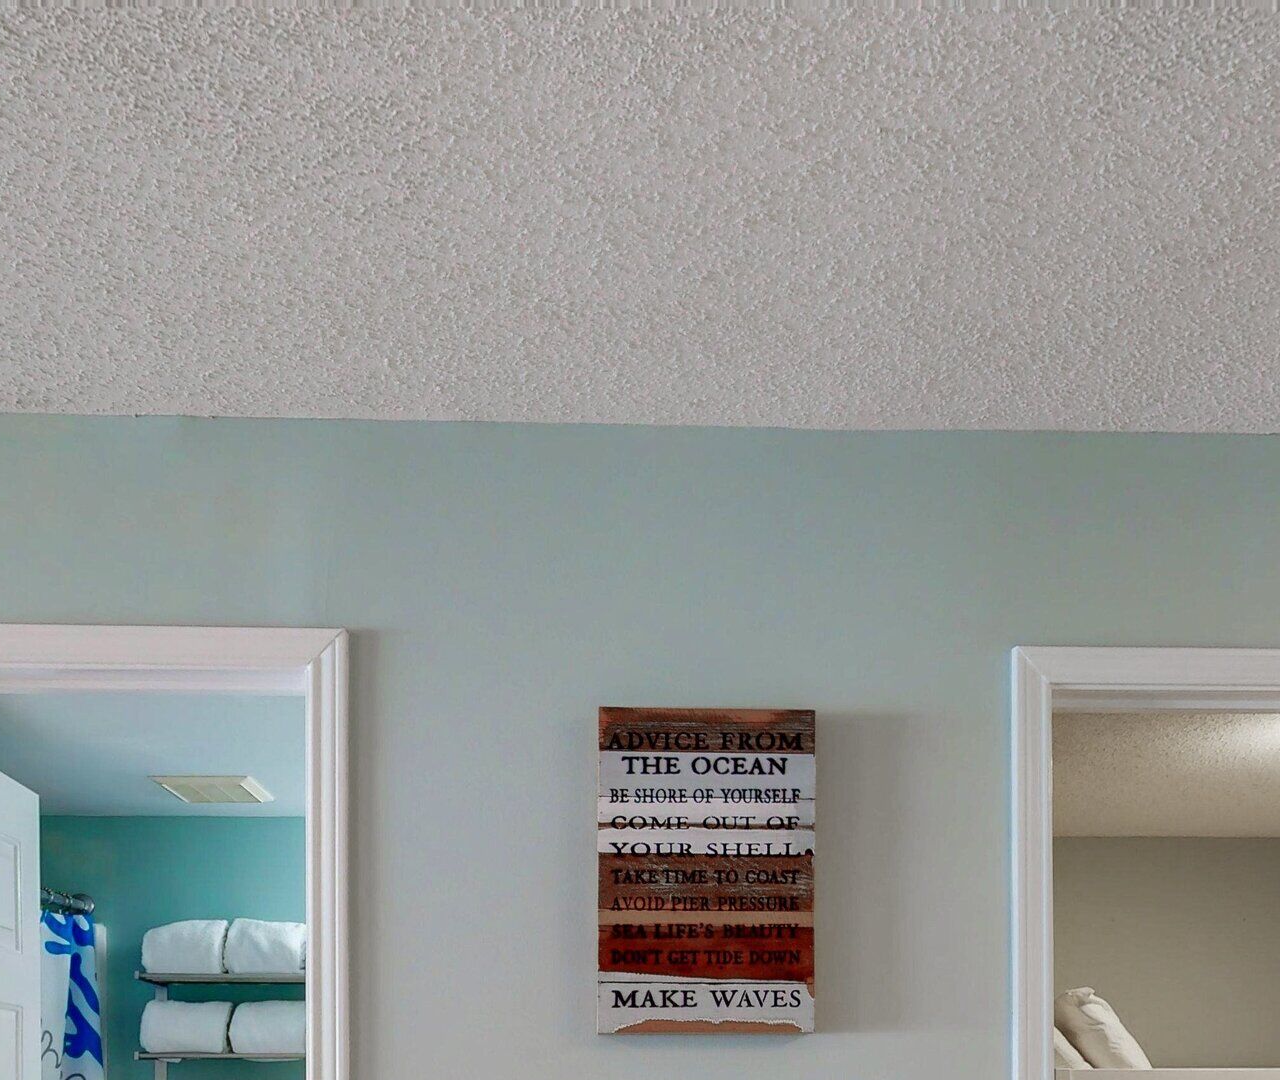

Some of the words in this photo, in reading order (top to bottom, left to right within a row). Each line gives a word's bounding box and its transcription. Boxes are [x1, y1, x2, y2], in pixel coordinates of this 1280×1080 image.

[607, 732, 709, 750] ADVICE
[722, 732, 804, 750] FROM
[622, 757, 680, 774] THE
[691, 757, 787, 775] OCEAN
[610, 789, 629, 803] BE
[634, 788, 687, 803] SHORE
[693, 789, 714, 803] OF
[721, 789, 800, 803] YOURSELF
[610, 816, 689, 830] COME
[703, 816, 756, 830] OUT
[767, 816, 800, 830] OF
[609, 842, 695, 857] YOUR
[706, 843, 801, 857] SHELL
[611, 869, 658, 884] TAKE
[663, 870, 708, 884] TIME
[716, 870, 738, 884] TO
[746, 870, 800, 884] COAST
[611, 897, 665, 911] AVOID
[671, 897, 709, 911] PIER
[720, 897, 799, 911] PRESSURE
[613, 924, 647, 938] SEA
[654, 923, 714, 939] LIFE'S
[723, 924, 799, 939] BEAUTY
[667, 950, 699, 964] GET
[704, 951, 743, 964] TIDE
[750, 951, 800, 964] DOWN
[611, 990, 697, 1008] MAKE
[710, 990, 801, 1008] WAVES
